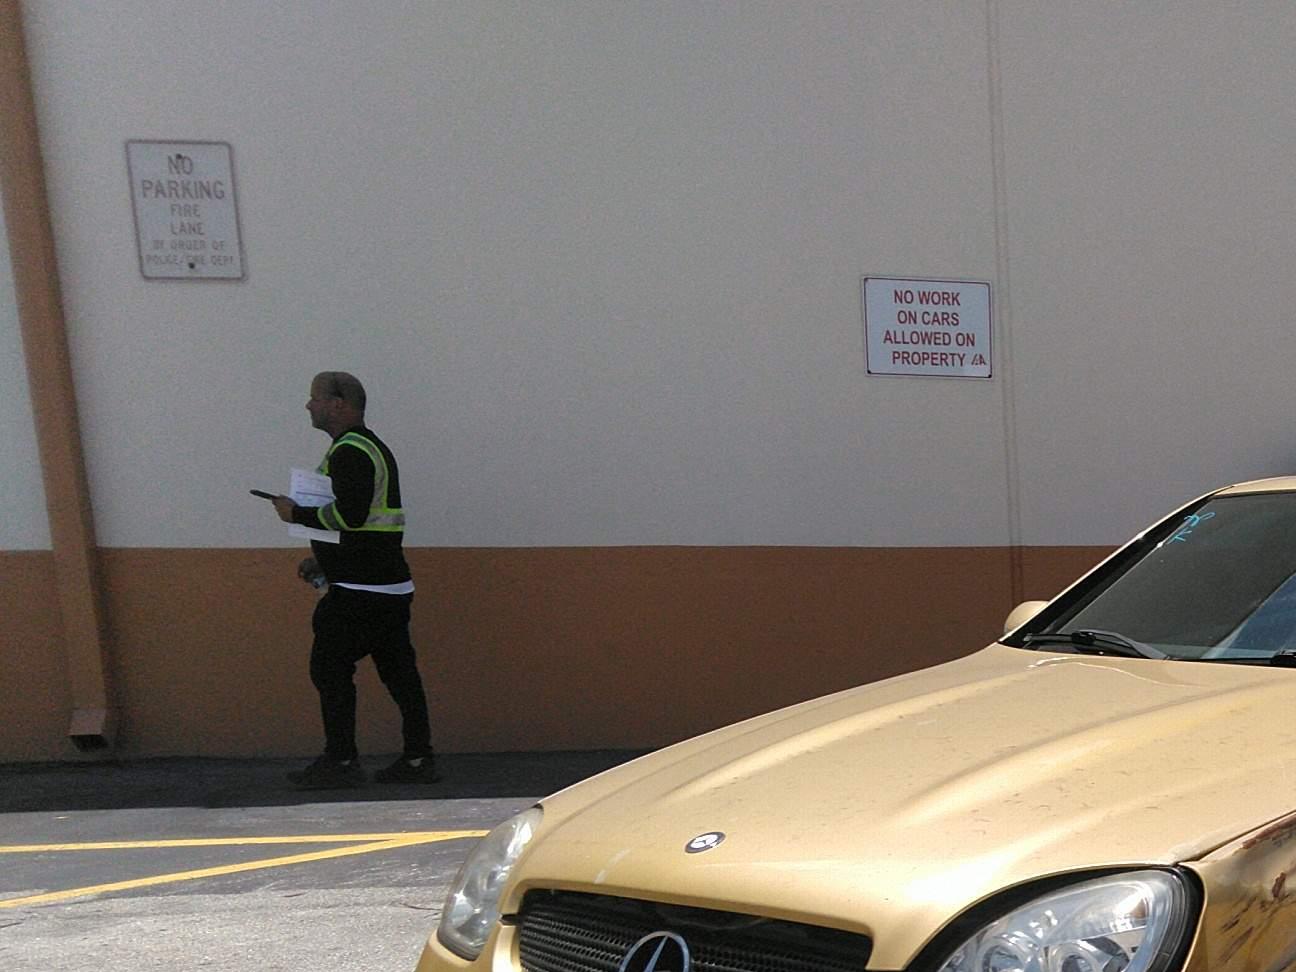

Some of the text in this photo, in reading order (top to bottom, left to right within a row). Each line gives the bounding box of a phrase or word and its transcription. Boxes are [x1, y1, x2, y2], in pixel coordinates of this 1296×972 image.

[167, 155, 194, 175] NO
[142, 180, 225, 199] PARKING
[170, 204, 200, 217] FIRE
[171, 222, 205, 236] LANE
[170, 239, 206, 250] ORDER
[894, 290, 961, 306] NO WORK
[897, 310, 960, 326] ON CARS
[883, 330, 975, 347] ALLOWED ON
[892, 351, 965, 367] PROPERTY
